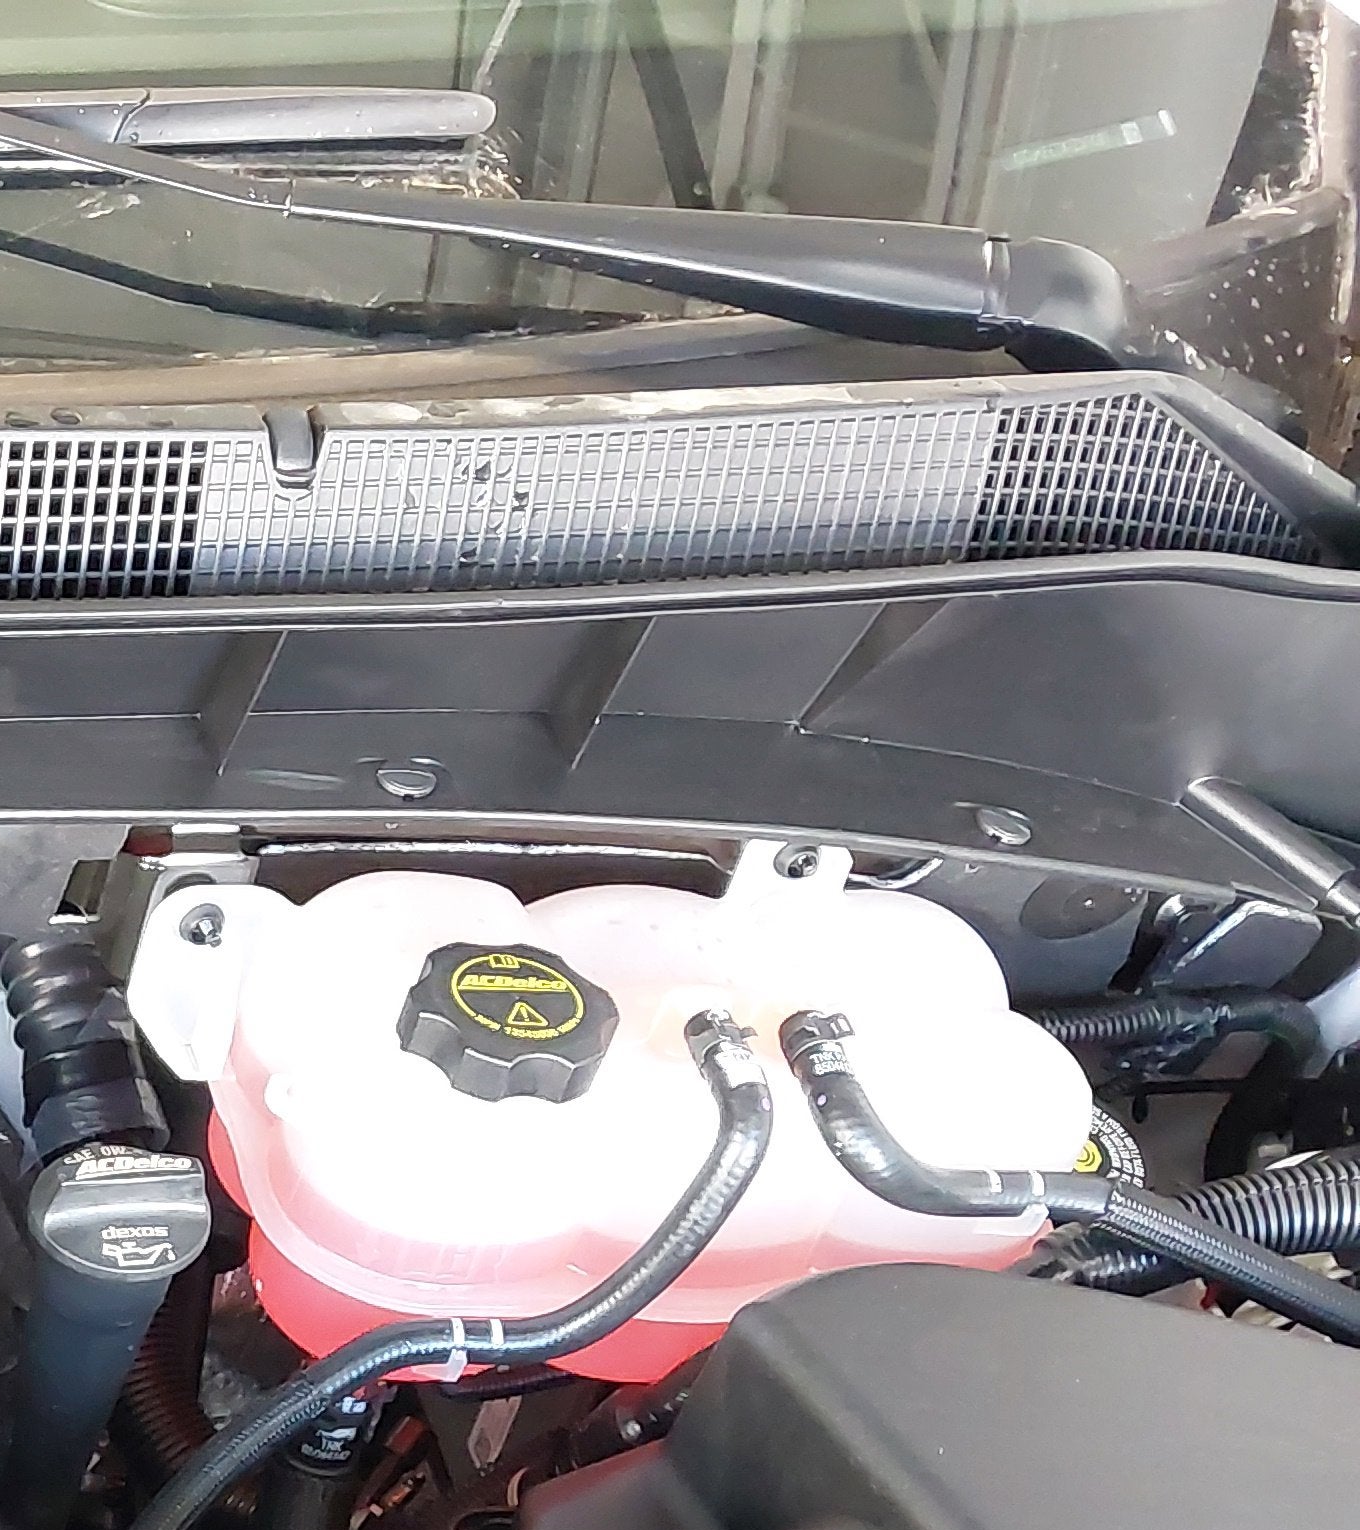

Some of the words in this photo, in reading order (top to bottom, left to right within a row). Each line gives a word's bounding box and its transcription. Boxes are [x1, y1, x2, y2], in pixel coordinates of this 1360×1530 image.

[460, 974, 567, 990] ACDelco
[75, 1155, 192, 1176] ACDelco
[101, 1225, 169, 1240] dexos
